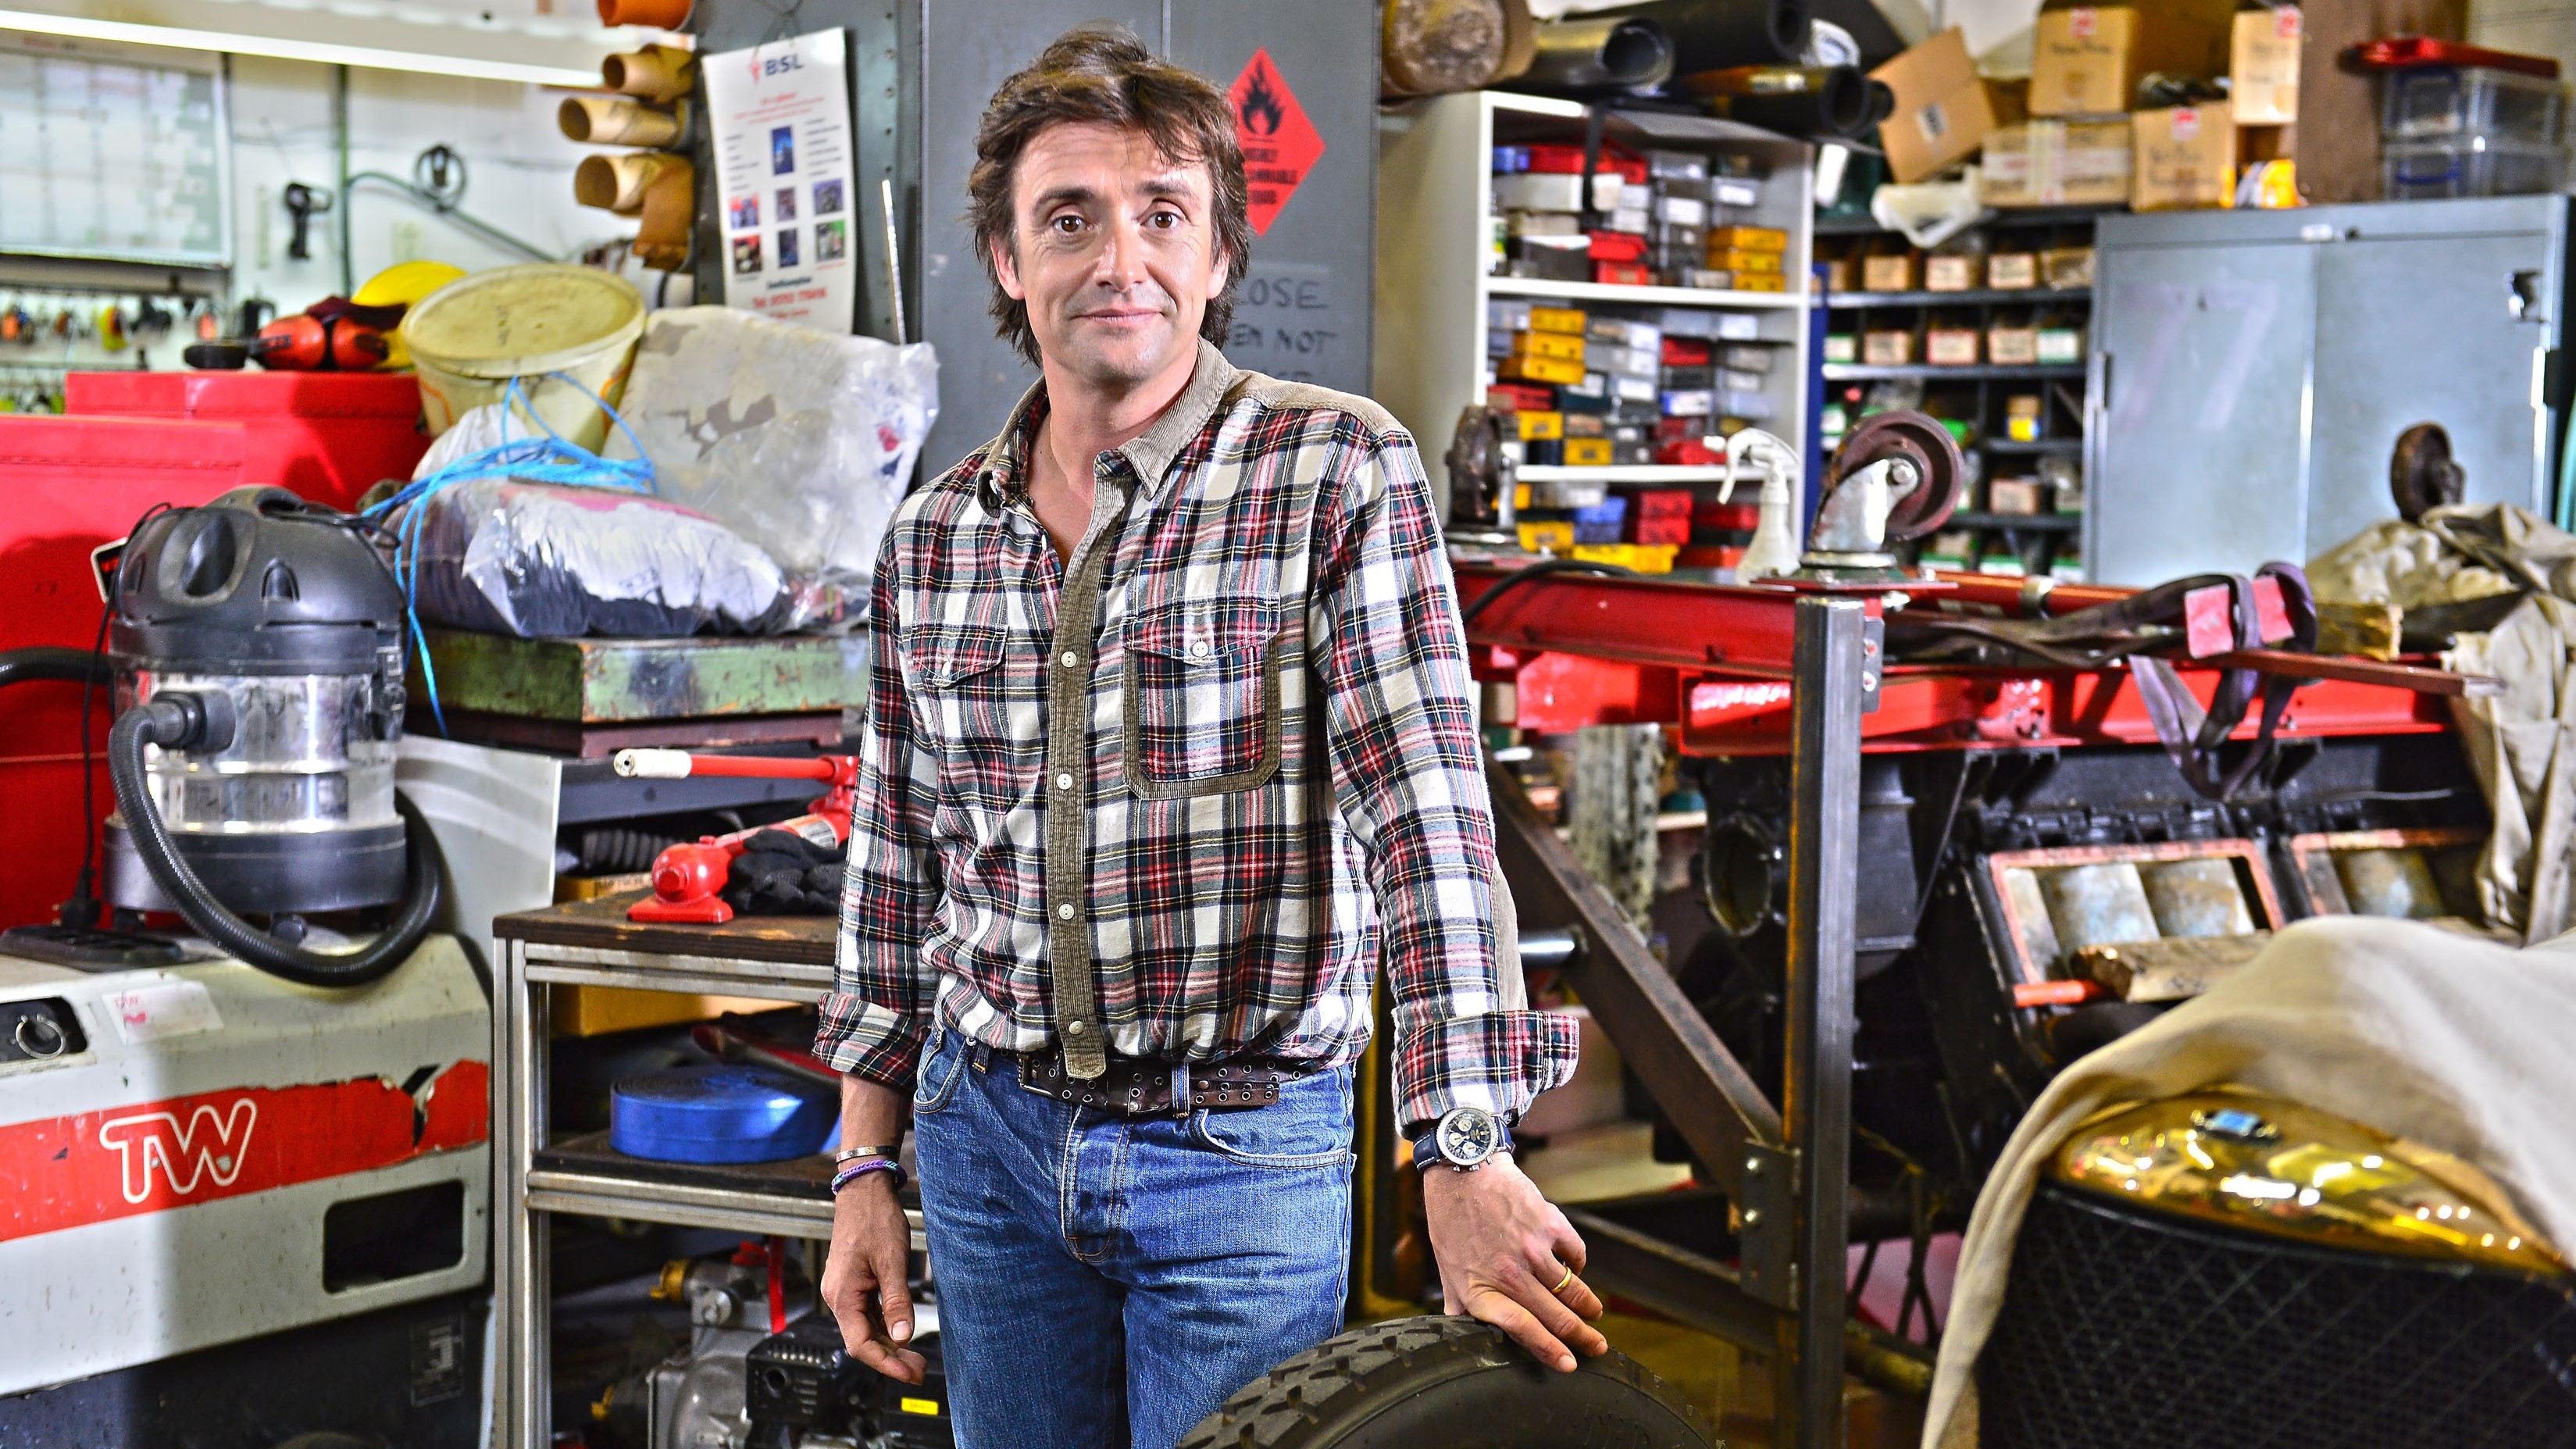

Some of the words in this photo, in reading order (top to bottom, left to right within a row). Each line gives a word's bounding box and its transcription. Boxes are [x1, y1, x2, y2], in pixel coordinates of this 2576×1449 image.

[765, 52, 805, 77] BSL
[1240, 277, 1329, 309] OSE
[1233, 323, 1263, 348] EN
[1274, 328, 1337, 354] NOT
[99, 1097, 257, 1204] TW
